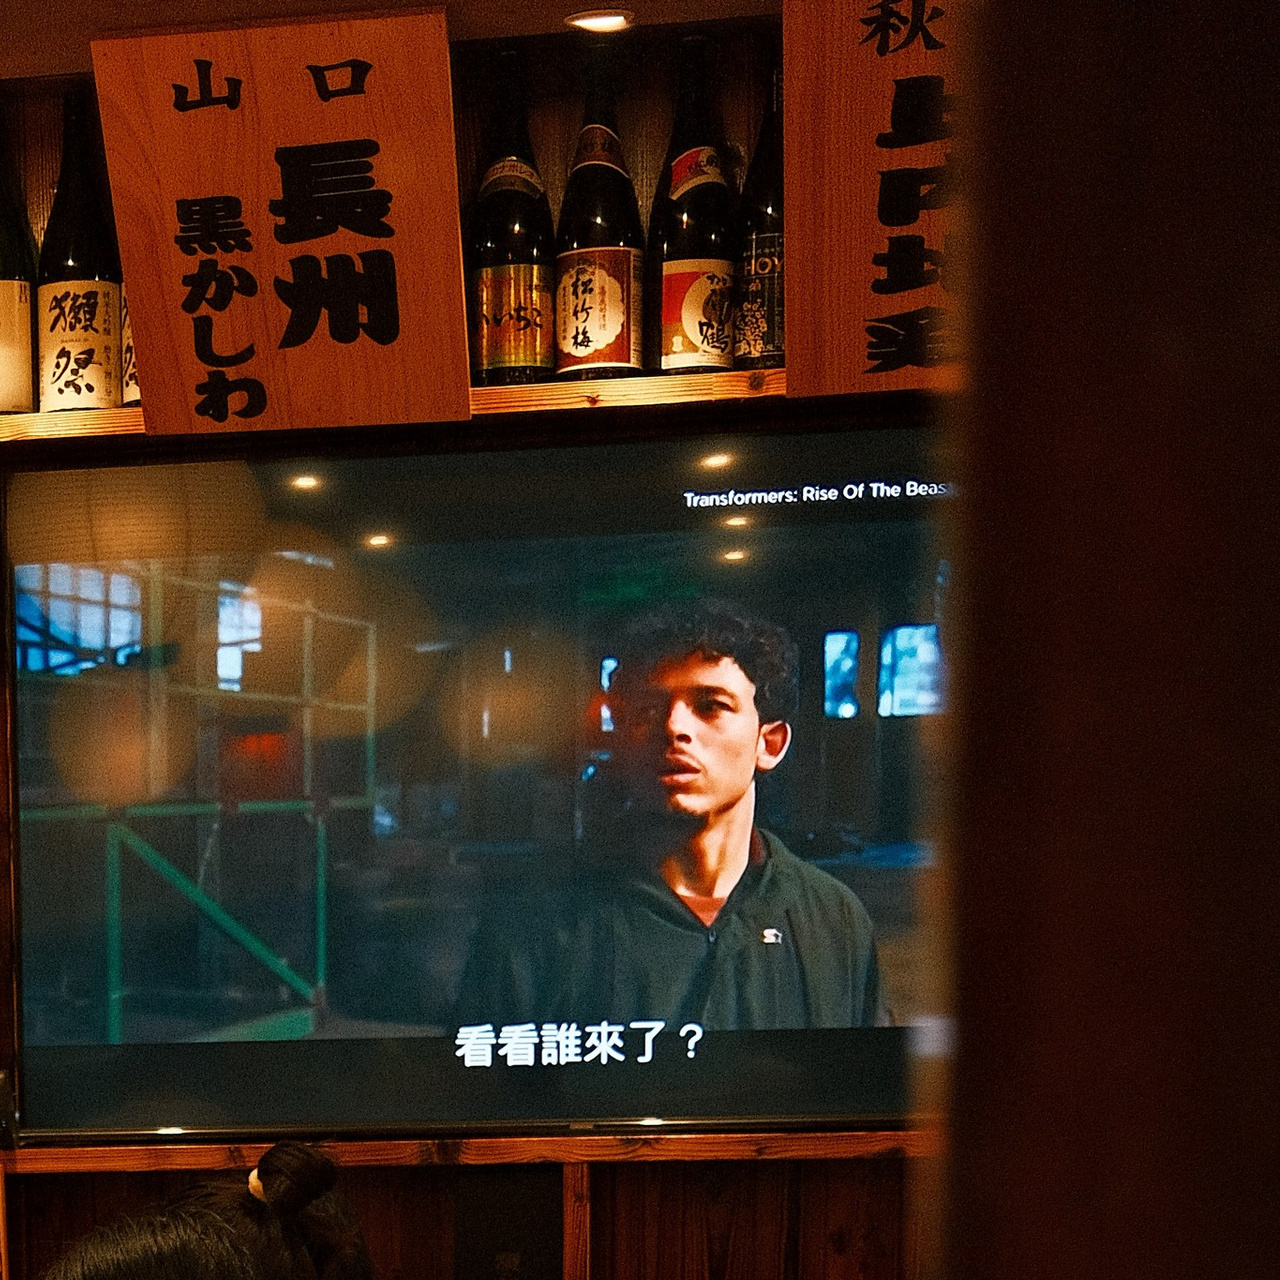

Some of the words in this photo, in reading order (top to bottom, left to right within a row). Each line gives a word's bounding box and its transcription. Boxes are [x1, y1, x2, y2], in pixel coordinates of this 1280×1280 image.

[171, 59, 374, 113] 山口
[268, 138, 400, 350] 長州
[49, 290, 101, 396] 獺祭
[173, 195, 268, 423] 黒かしわ
[683, 489, 798, 508] Transformers:
[803, 485, 838, 502] Rise
[843, 483, 865, 499] Of
[869, 482, 901, 498] The
[906, 481, 958, 497] Beas
[455, 1021, 704, 1067] 看看誰來了？
